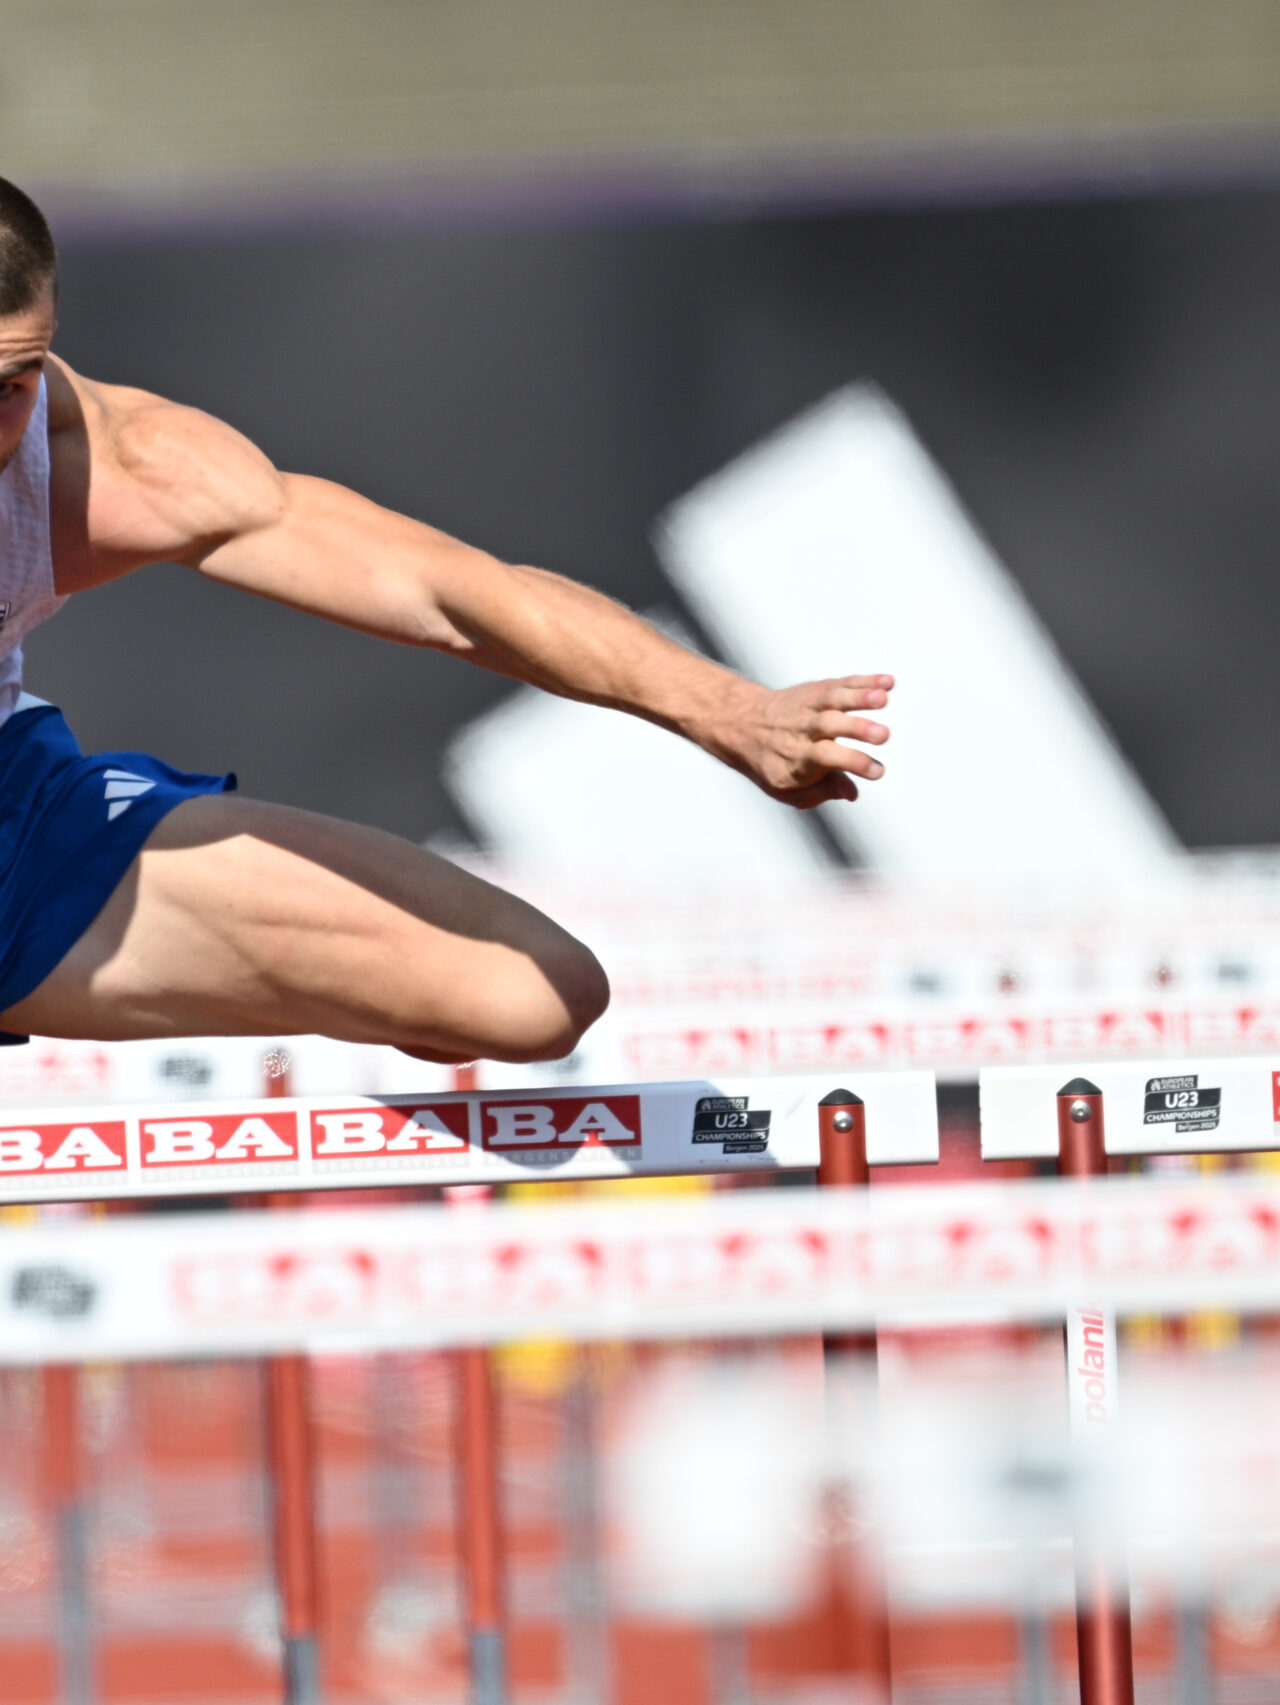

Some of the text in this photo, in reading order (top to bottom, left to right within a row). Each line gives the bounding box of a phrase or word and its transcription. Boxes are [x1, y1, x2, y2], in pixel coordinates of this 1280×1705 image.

[1165, 1091, 1199, 1109] U23
[487, 1103, 635, 1146] BA
[715, 1112, 748, 1129] U23
[1146, 1109, 1217, 1122] CHAMPIONSHIPS
[144, 1118, 293, 1163] BA
[316, 1110, 464, 1154] BA
[696, 1131, 767, 1142] CHAMPIONSHIPS
